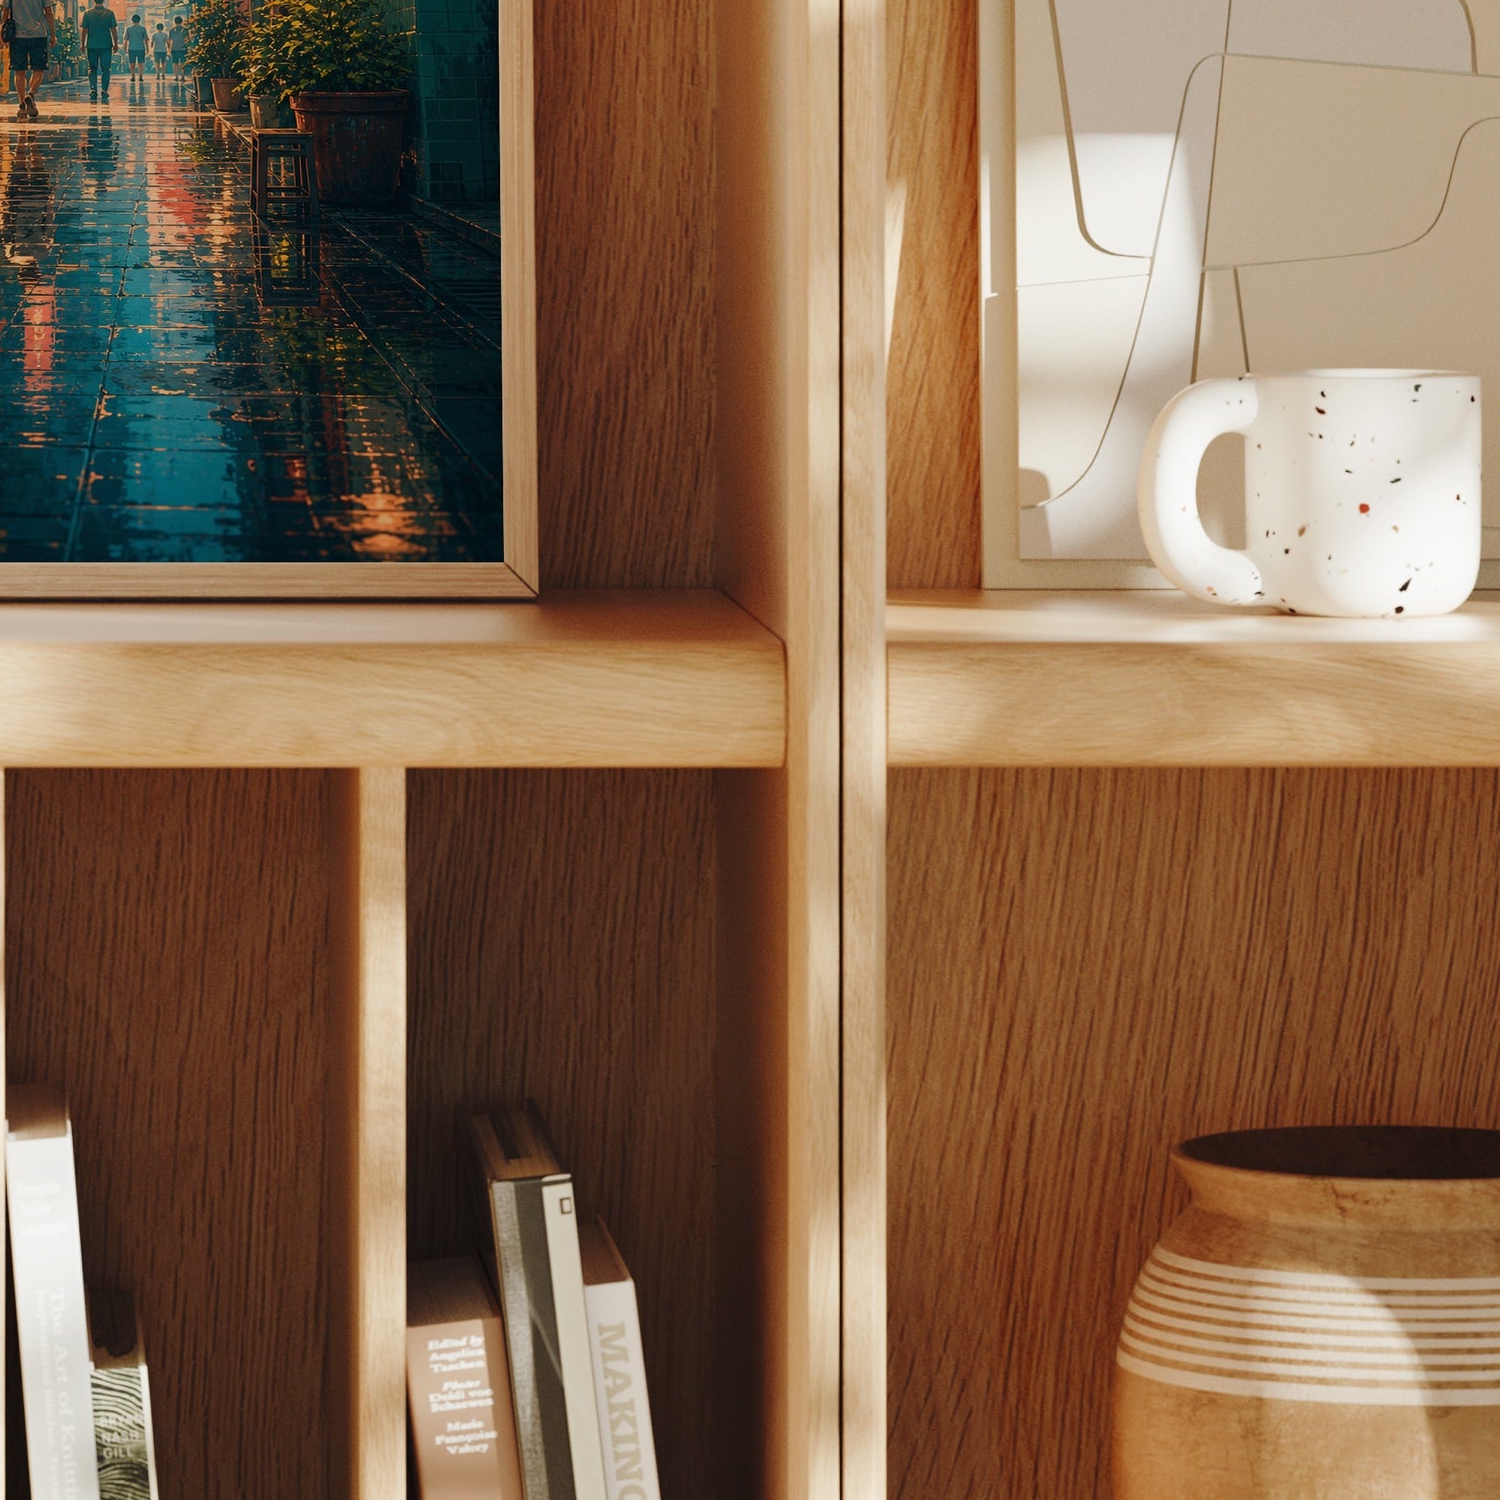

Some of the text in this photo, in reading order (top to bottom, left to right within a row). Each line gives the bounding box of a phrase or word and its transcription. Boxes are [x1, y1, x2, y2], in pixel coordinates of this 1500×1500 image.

[51, 1286, 67, 1335] The
[54, 1342, 70, 1388] Art
[58, 1391, 74, 1419] of
[103, 1446, 133, 1460] GILL
